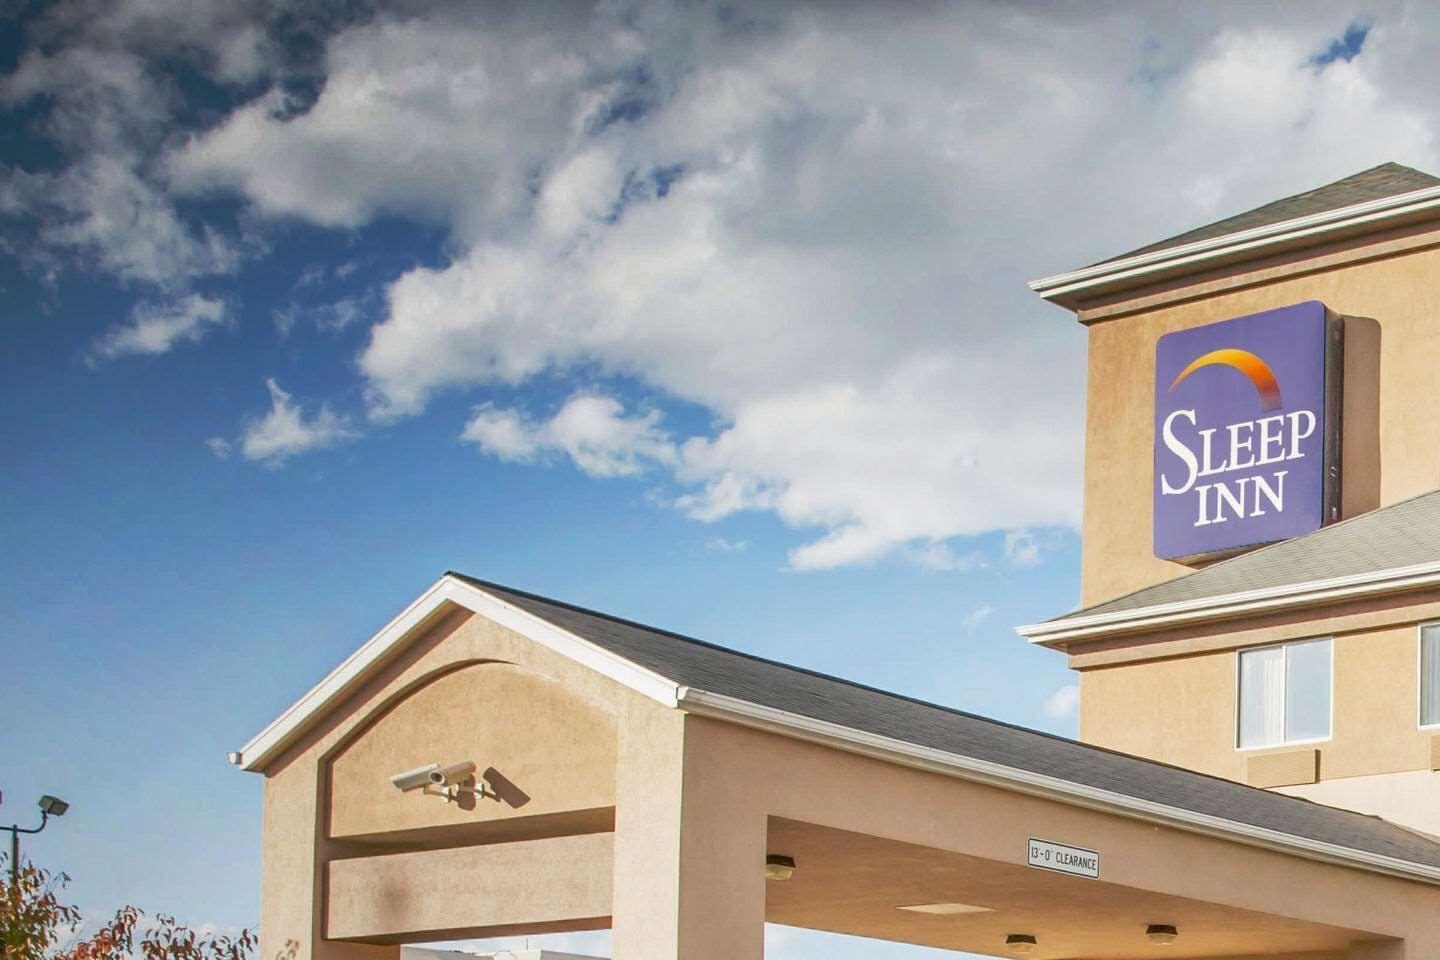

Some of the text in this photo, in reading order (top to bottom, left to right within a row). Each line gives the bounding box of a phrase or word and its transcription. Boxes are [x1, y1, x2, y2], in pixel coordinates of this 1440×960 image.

[1161, 409, 1316, 495] SLEEP
[1194, 471, 1288, 527] INN
[1056, 851, 1096, 871] CLEARANCE
